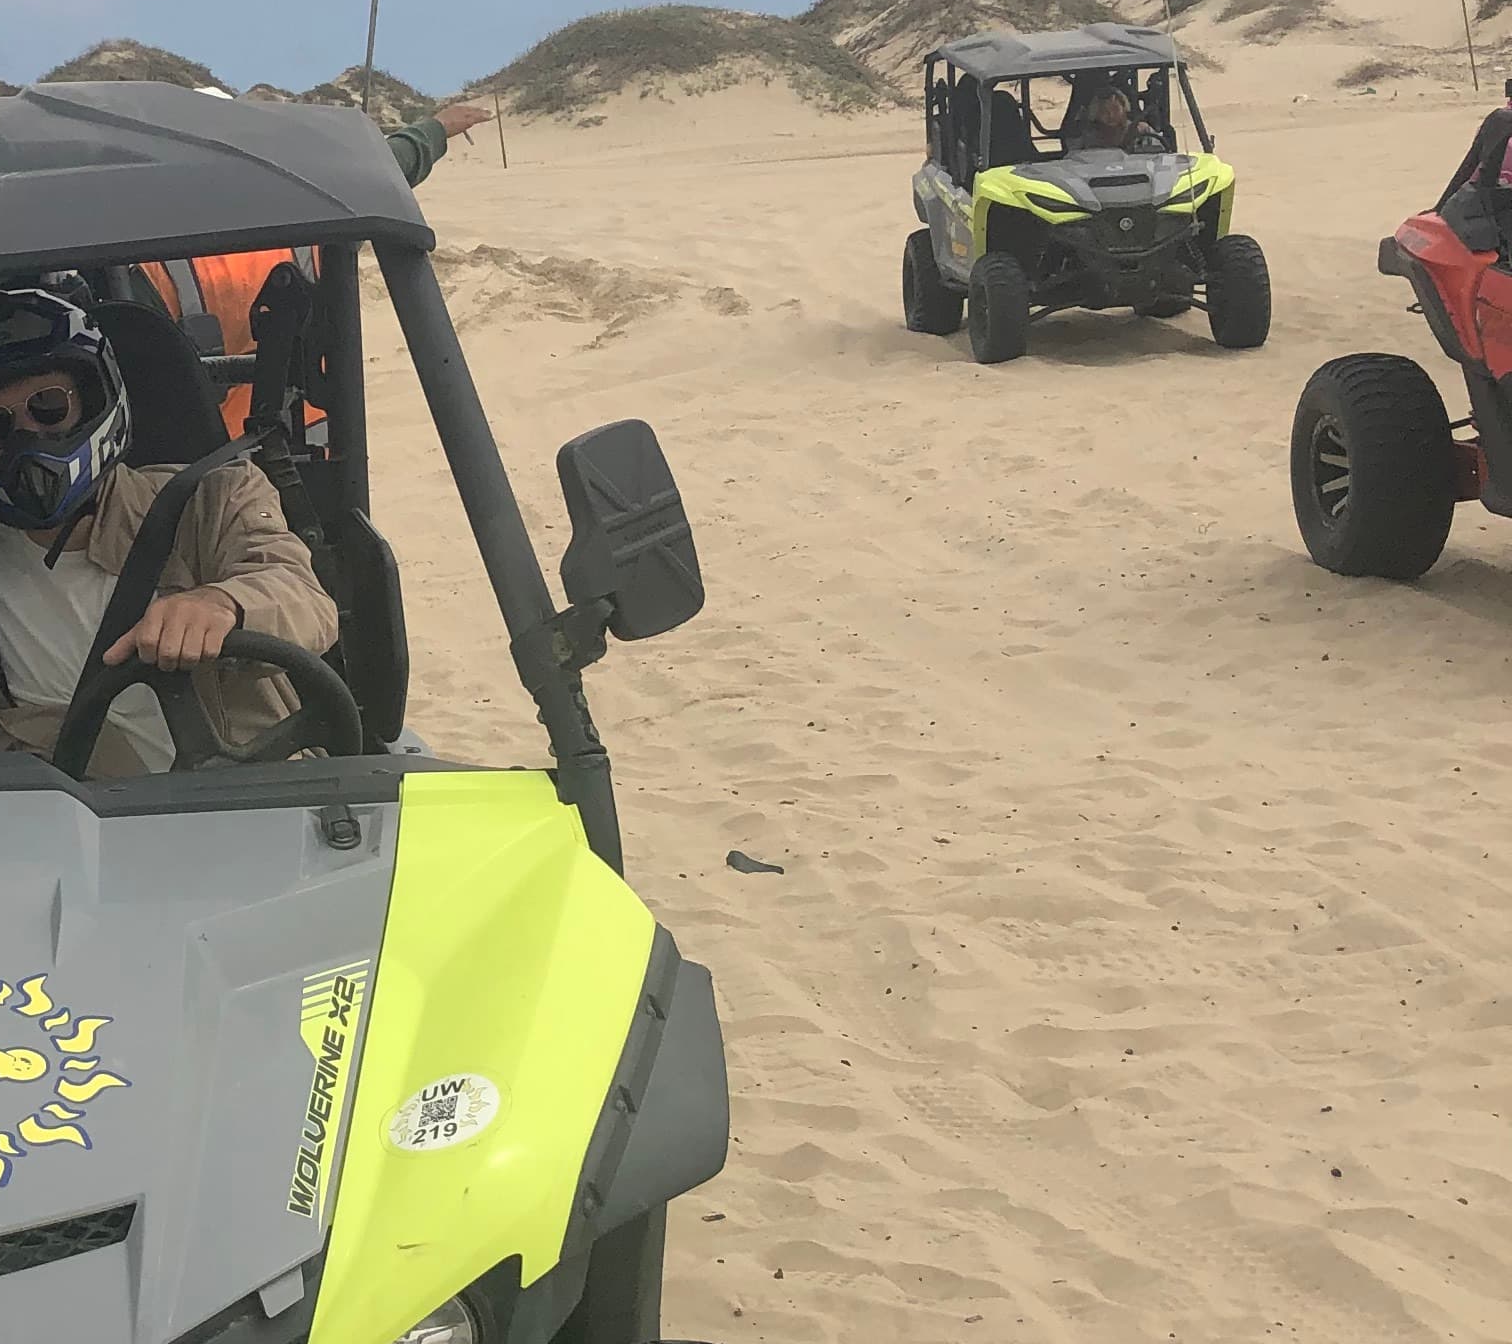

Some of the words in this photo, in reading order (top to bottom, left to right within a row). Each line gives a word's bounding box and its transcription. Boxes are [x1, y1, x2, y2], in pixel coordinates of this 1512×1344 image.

[287, 1025, 346, 1217] WOLVERINE
[328, 975, 356, 1027] X2
[421, 1078, 466, 1102] UW
[411, 1122, 458, 1145] 219
